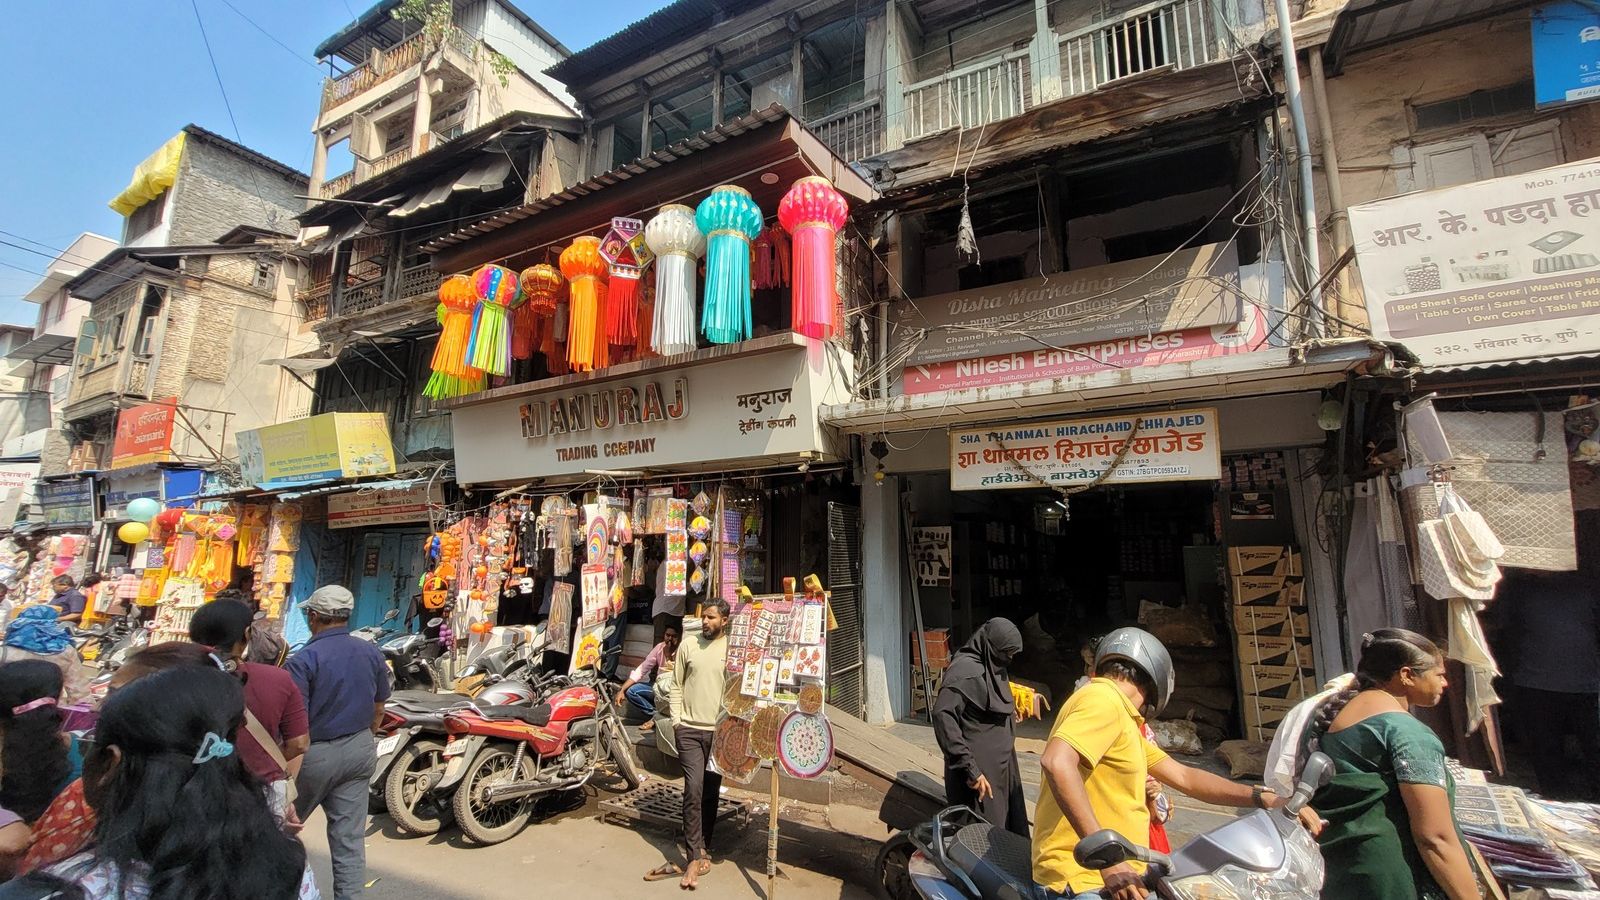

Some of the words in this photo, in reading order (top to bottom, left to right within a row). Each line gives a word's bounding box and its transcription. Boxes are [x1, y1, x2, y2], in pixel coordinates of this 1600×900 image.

[1525, 179, 1557, 189] Mob.
[1372, 222, 1432, 247] आर.
[1438, 209, 1478, 234] के.
[1483, 197, 1558, 225] पडदा
[947, 295, 1004, 315] Disha
[1008, 277, 1117, 304] Marketing
[1397, 302, 1418, 311] Bed
[1420, 298, 1451, 308] Sheet
[1459, 292, 1485, 303] Sofa
[1488, 286, 1521, 298] Cover
[1530, 279, 1582, 292] Washing
[1422, 309, 1449, 318] Table
[1452, 304, 1487, 314] Cover
[1494, 299, 1526, 309] Saree
[1530, 293, 1564, 303] Cover
[1473, 312, 1499, 322] Own
[1502, 308, 1536, 318] Cover
[1546, 301, 1578, 313] Table
[945, 333, 984, 344] Channel
[1434, 344, 1469, 355] ३३२,
[1474, 337, 1517, 350] रविवार
[1521, 333, 1551, 343] पेठ,
[1556, 328, 1578, 343] पुणे
[939, 380, 961, 389] Channel
[962, 378, 983, 387] Partner
[999, 371, 1034, 381] Institutional
[1042, 368, 1066, 378] Schools
[1075, 364, 1091, 372] Bata
[1162, 348, 1209, 360] Maharashtra
[956, 353, 1025, 378] Nilesh
[1033, 332, 1184, 367] Enterprises
[519, 377, 689, 438] MANURAJ
[736, 388, 792, 413] मनुराज
[767, 413, 796, 429] कंपनी
[960, 434, 980, 444] SHA
[986, 428, 1052, 442] THANMAL
[1137, 414, 1205, 430] CHHAJED
[556, 443, 598, 462] TRADING
[958, 450, 980, 468] शा.
[983, 445, 1049, 463] थानमल
[1054, 435, 1126, 463] हिराचंद
[1132, 429, 1206, 454] छाजेड
